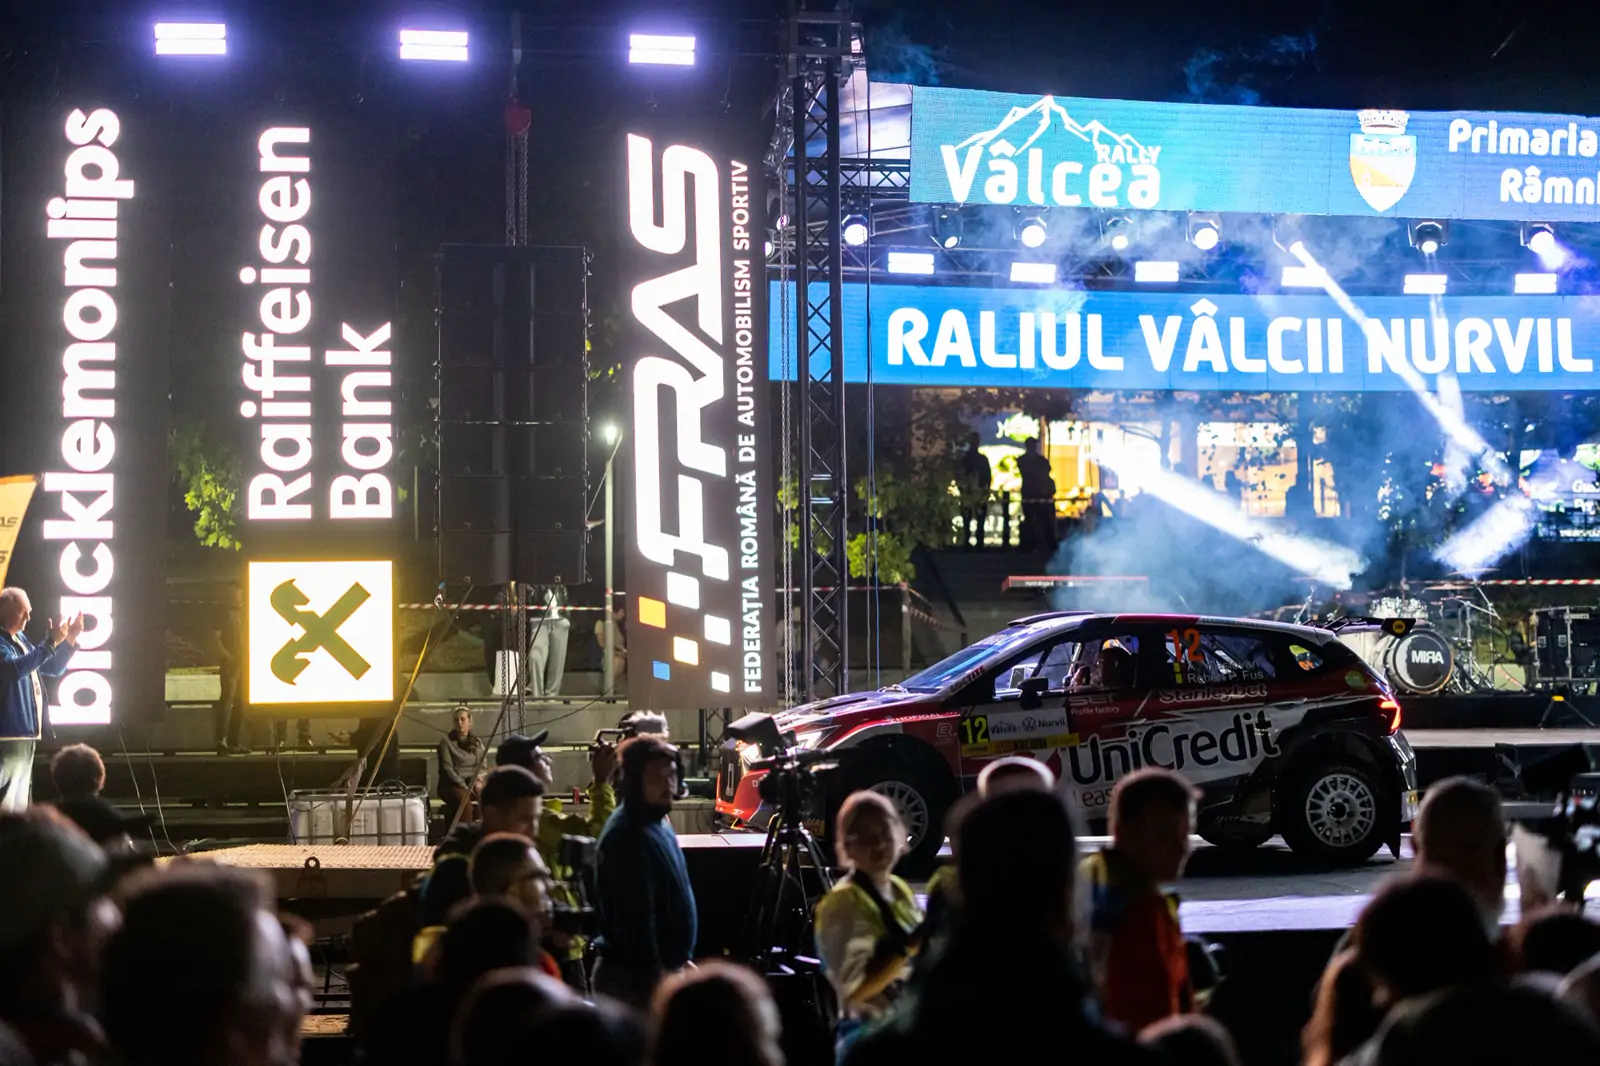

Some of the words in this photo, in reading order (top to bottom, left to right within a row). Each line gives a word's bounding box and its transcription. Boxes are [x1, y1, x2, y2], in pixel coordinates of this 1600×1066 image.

[940, 138, 1161, 208] Vâlcea
[1096, 143, 1162, 164] RALLY
[1449, 118, 1598, 157] Primaria
[731, 160, 750, 251] SPORTIV
[239, 126, 312, 520] Raiffeisen
[627, 132, 730, 582] FRAS
[733, 259, 755, 427] AUTOMOBILISM
[887, 307, 1124, 371] RALIUL
[1138, 297, 1344, 374] VÂLCII
[1366, 317, 1594, 374] NURVIL
[47, 108, 135, 725] blacklemonlips
[325, 321, 393, 519] Bank
[738, 434, 756, 462] DE
[735, 470, 759, 569] ROMÂNĂ
[1165, 627, 1205, 662] 12
[961, 716, 989, 745] 12
[1038, 715, 1066, 728] Nurvil
[1159, 682, 1268, 704] Stanleybet
[1069, 710, 1281, 785] UniCredit
